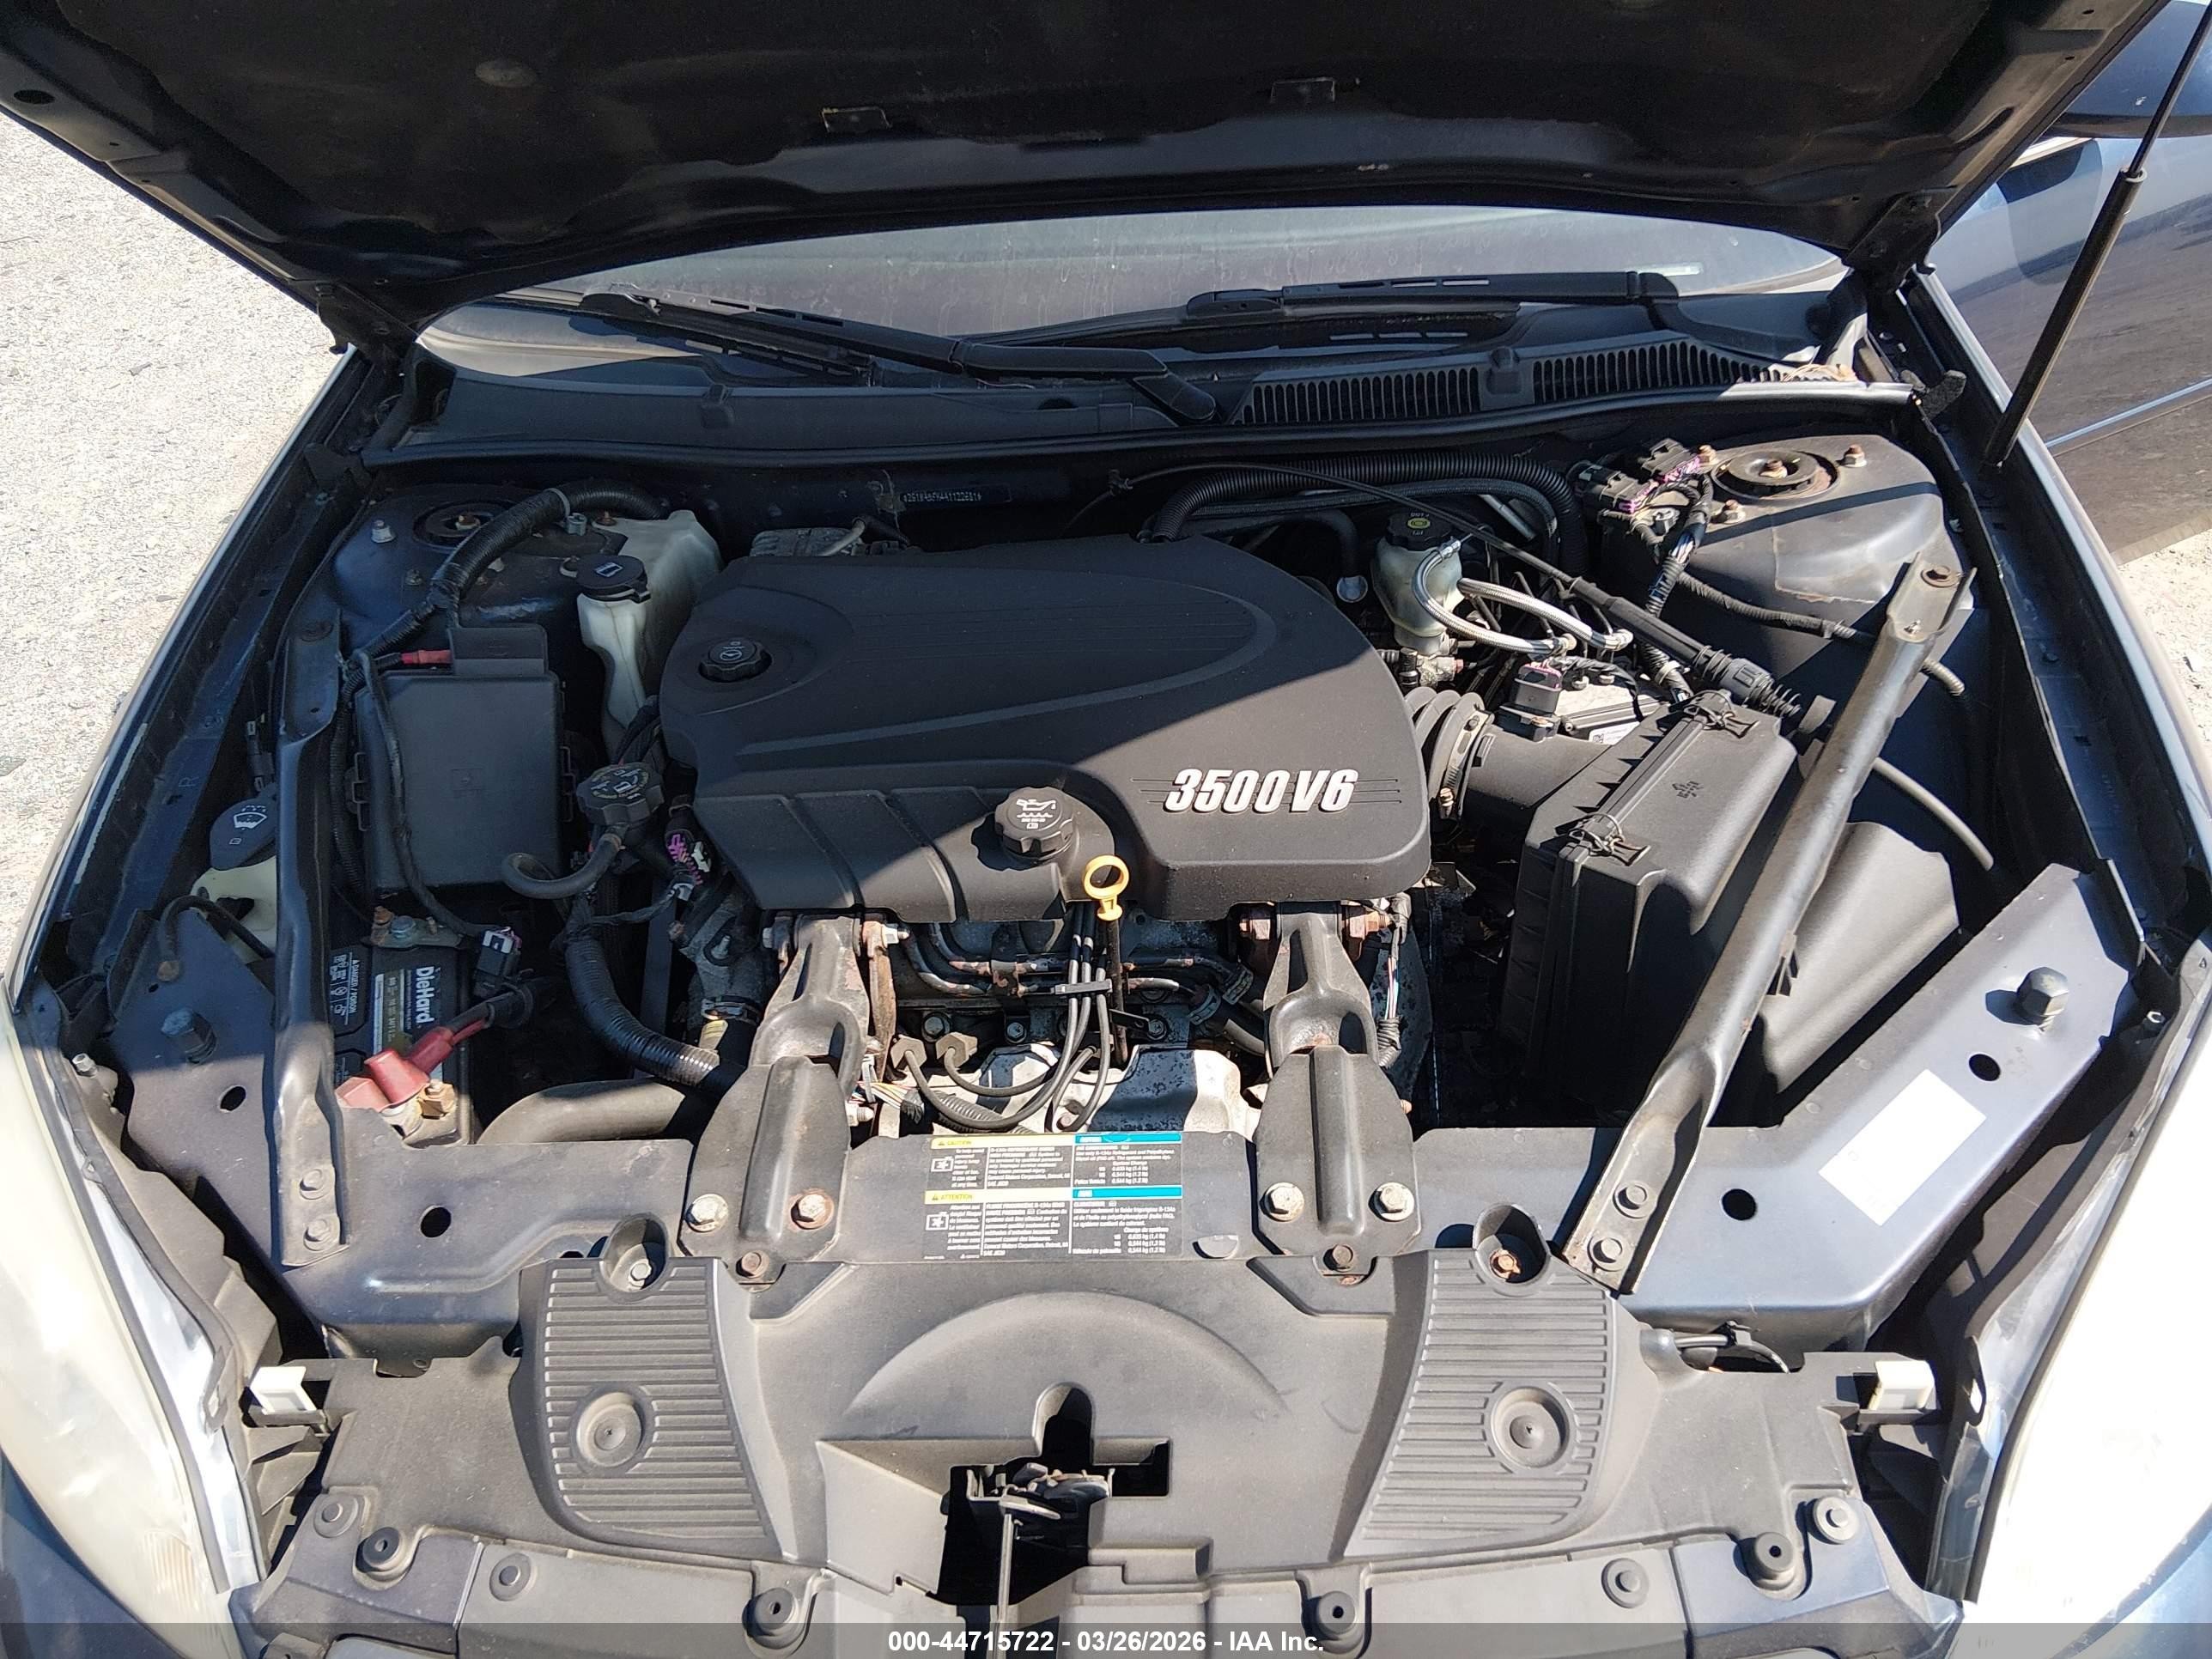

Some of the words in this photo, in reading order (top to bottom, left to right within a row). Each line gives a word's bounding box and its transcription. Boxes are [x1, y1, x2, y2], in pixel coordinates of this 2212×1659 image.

[1164, 769, 1291, 813] 3500
[1290, 769, 1358, 812] V6
[416, 966, 434, 1024] DieHard
